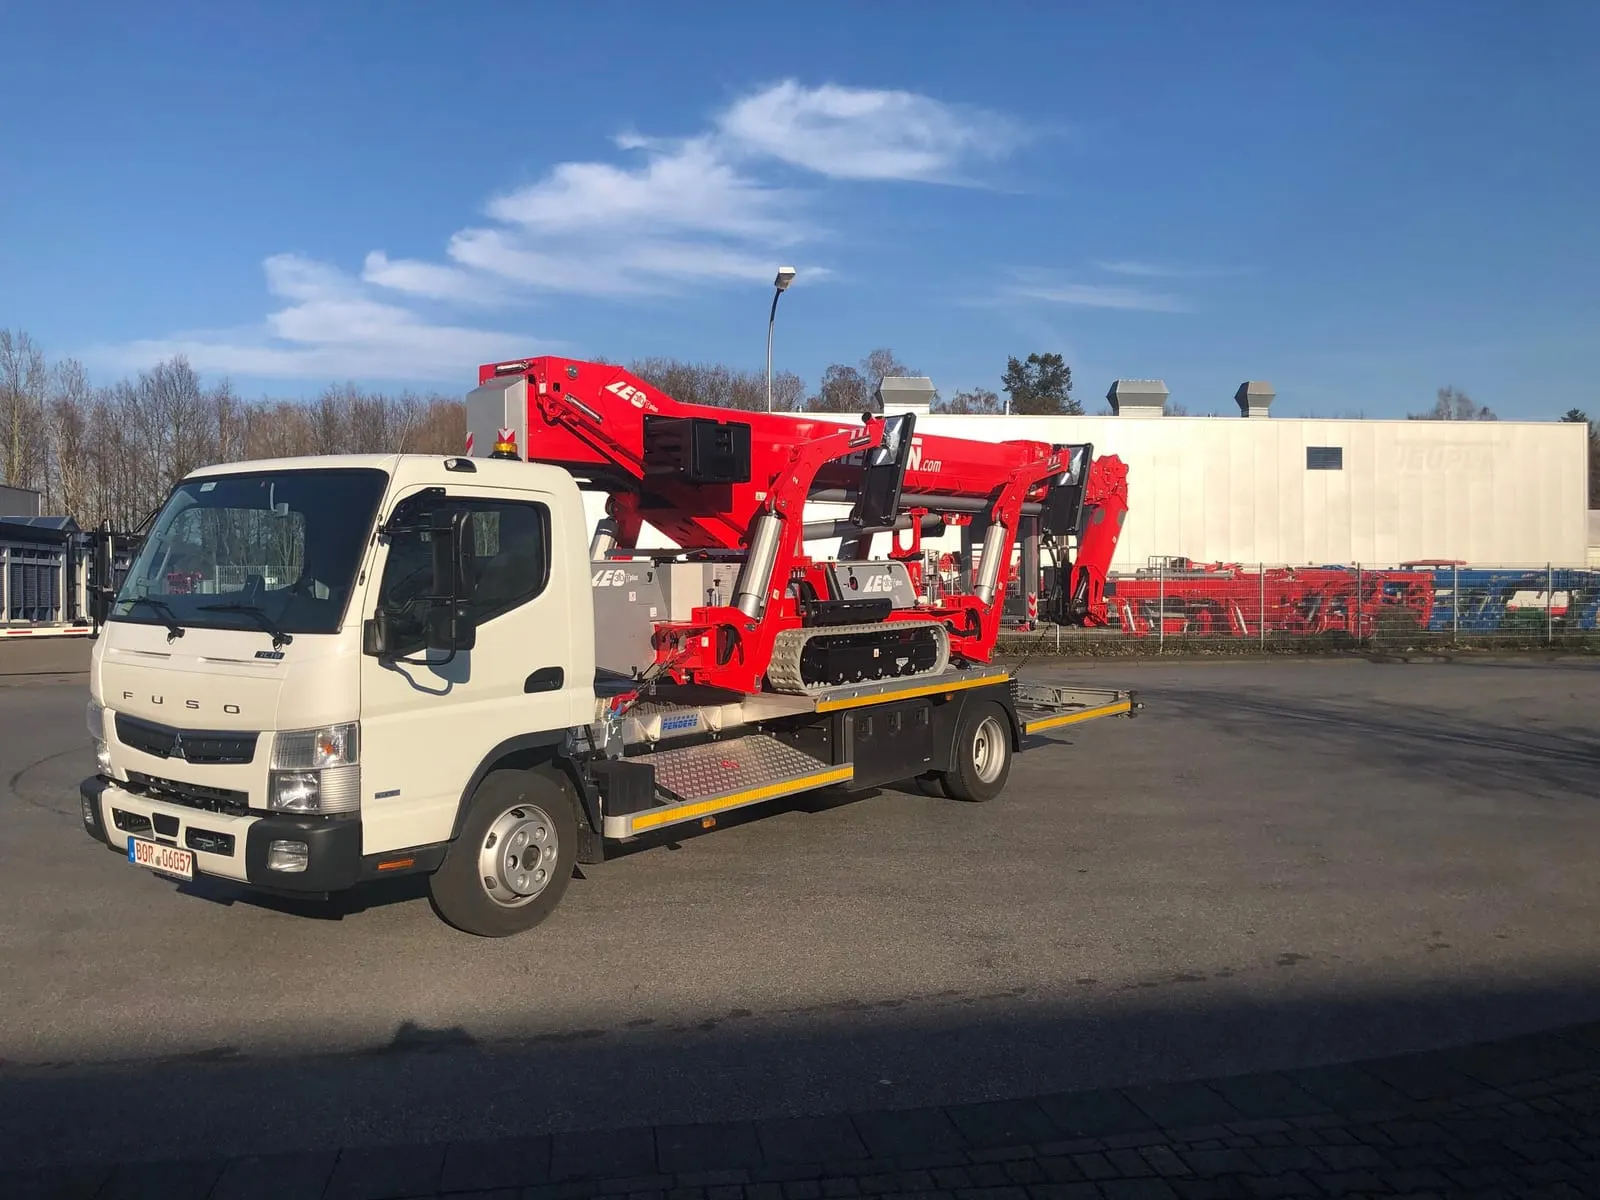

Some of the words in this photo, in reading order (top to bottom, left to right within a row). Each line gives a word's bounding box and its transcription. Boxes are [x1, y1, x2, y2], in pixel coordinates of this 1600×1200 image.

[605, 381, 647, 408] LEO
[906, 447, 942, 473] N.com
[592, 569, 625, 587] LEO
[863, 575, 892, 592] LEO
[123, 691, 240, 715] FUSO
[136, 842, 154, 864] BOR
[162, 848, 191, 873] 06057
